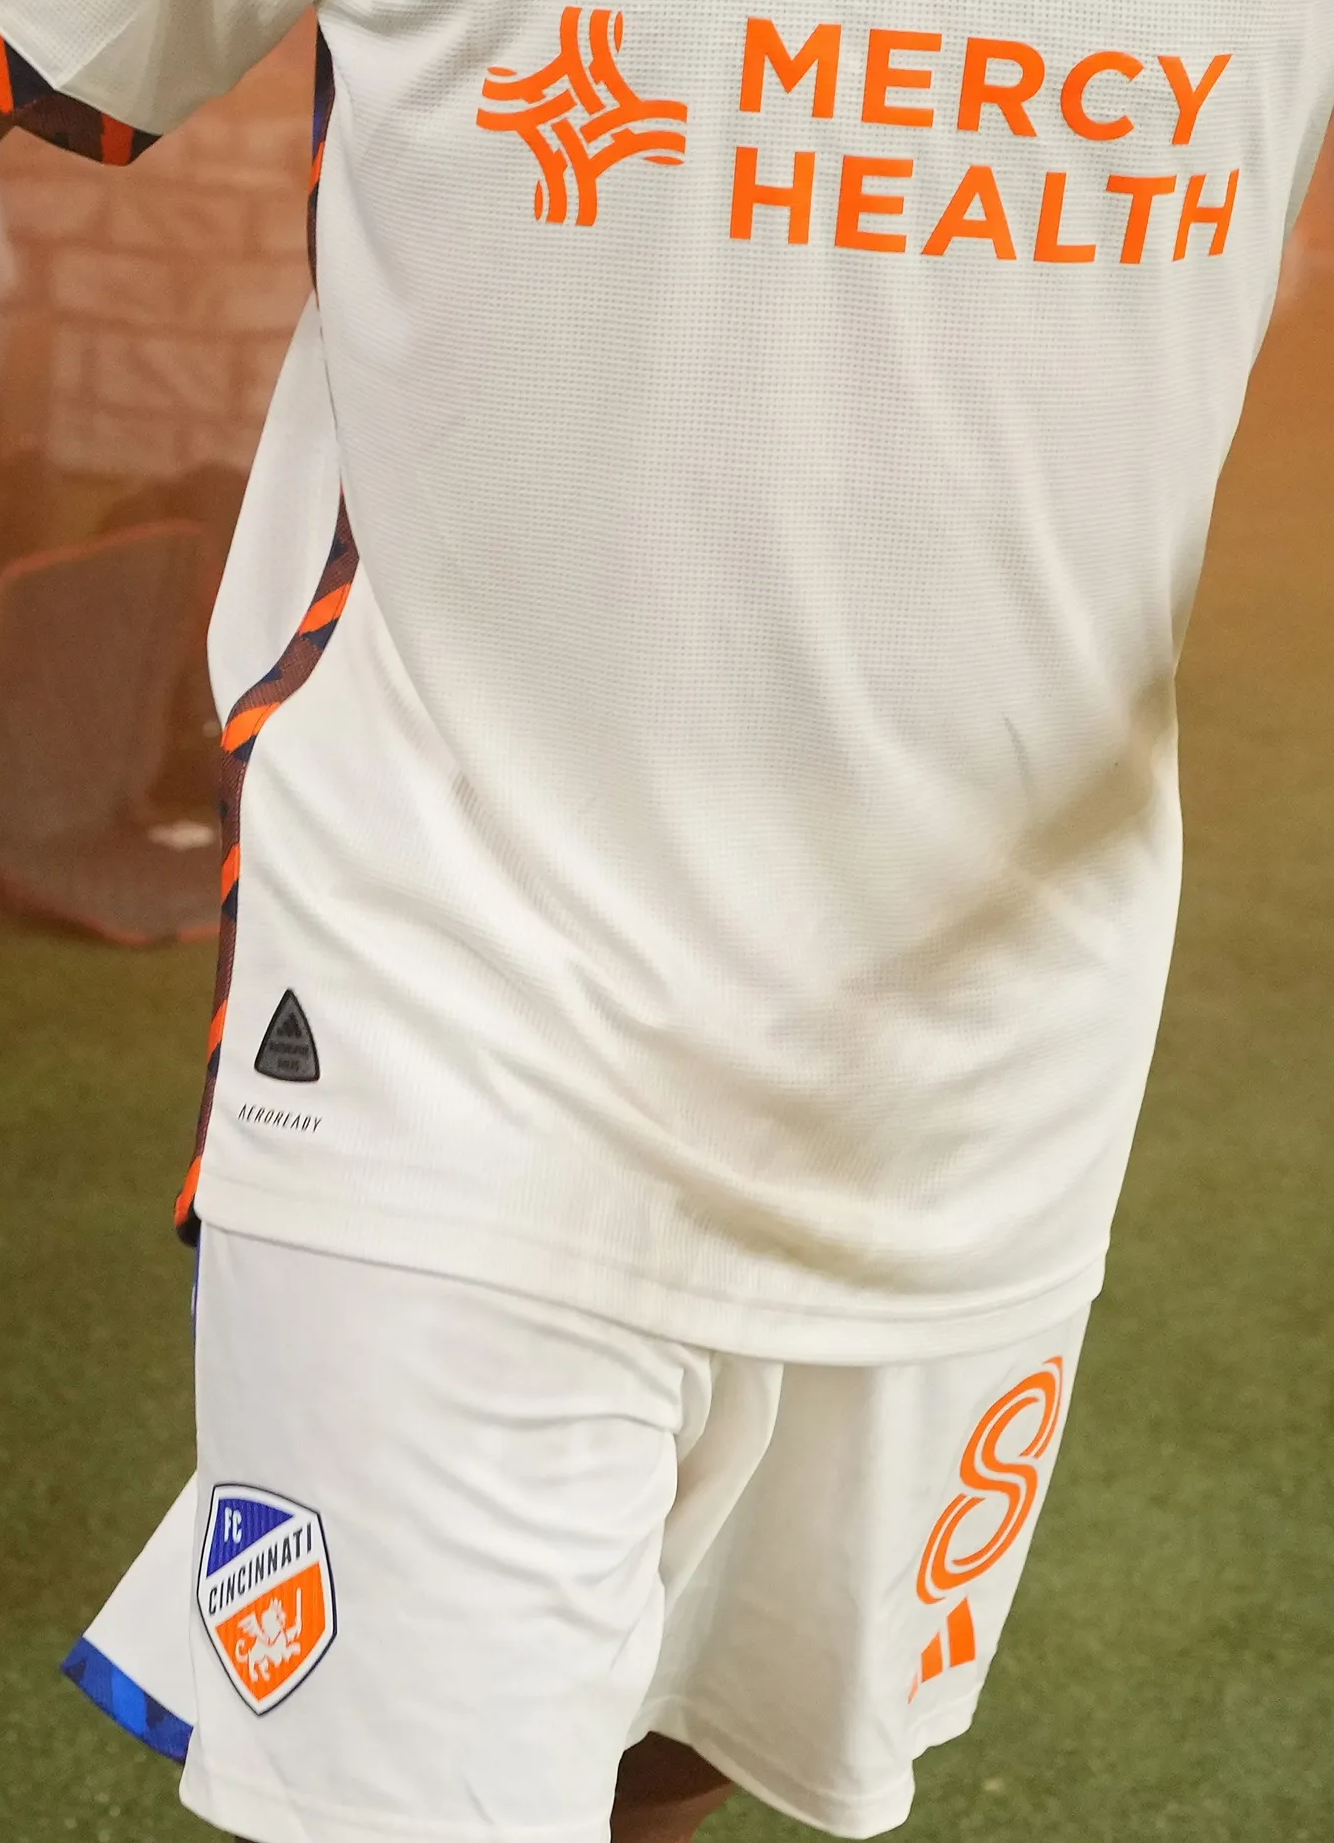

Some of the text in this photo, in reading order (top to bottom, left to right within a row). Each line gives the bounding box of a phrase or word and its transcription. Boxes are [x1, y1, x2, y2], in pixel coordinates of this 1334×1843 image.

[740, 17, 1232, 146] MERCY
[729, 147, 1240, 264] HEALTH
[238, 1103, 322, 1133] AEROREADY
[223, 1506, 243, 1544] FC
[916, 1355, 1063, 1605] 8
[208, 1523, 312, 1616] CINCINNATI
